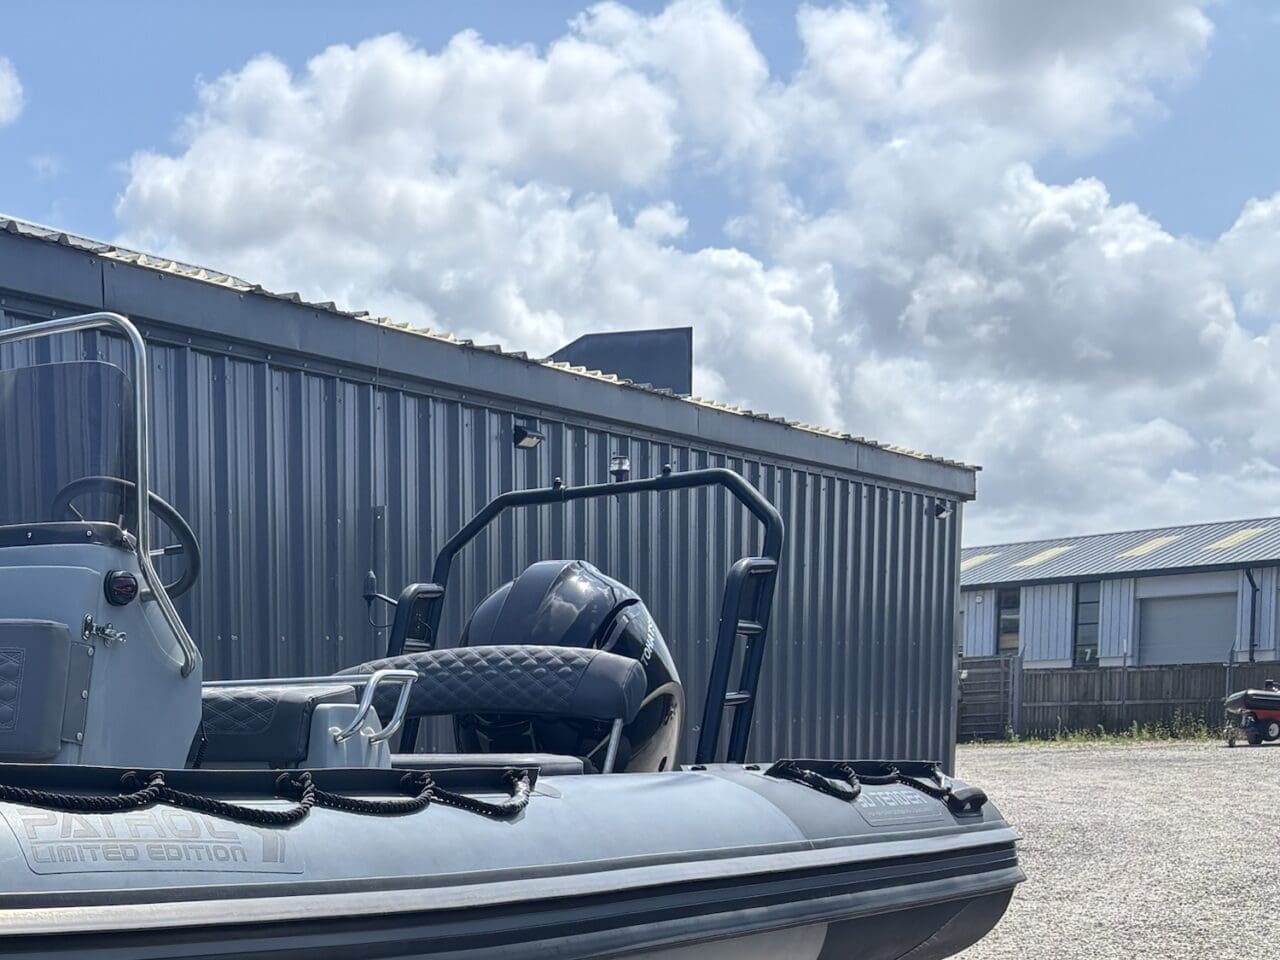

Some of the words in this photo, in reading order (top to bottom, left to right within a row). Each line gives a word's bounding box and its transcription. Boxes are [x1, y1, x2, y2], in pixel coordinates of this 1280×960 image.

[1084, 648, 1092, 661] 7
[31, 845, 139, 863] LIMITED
[147, 843, 248, 863] EDITION
